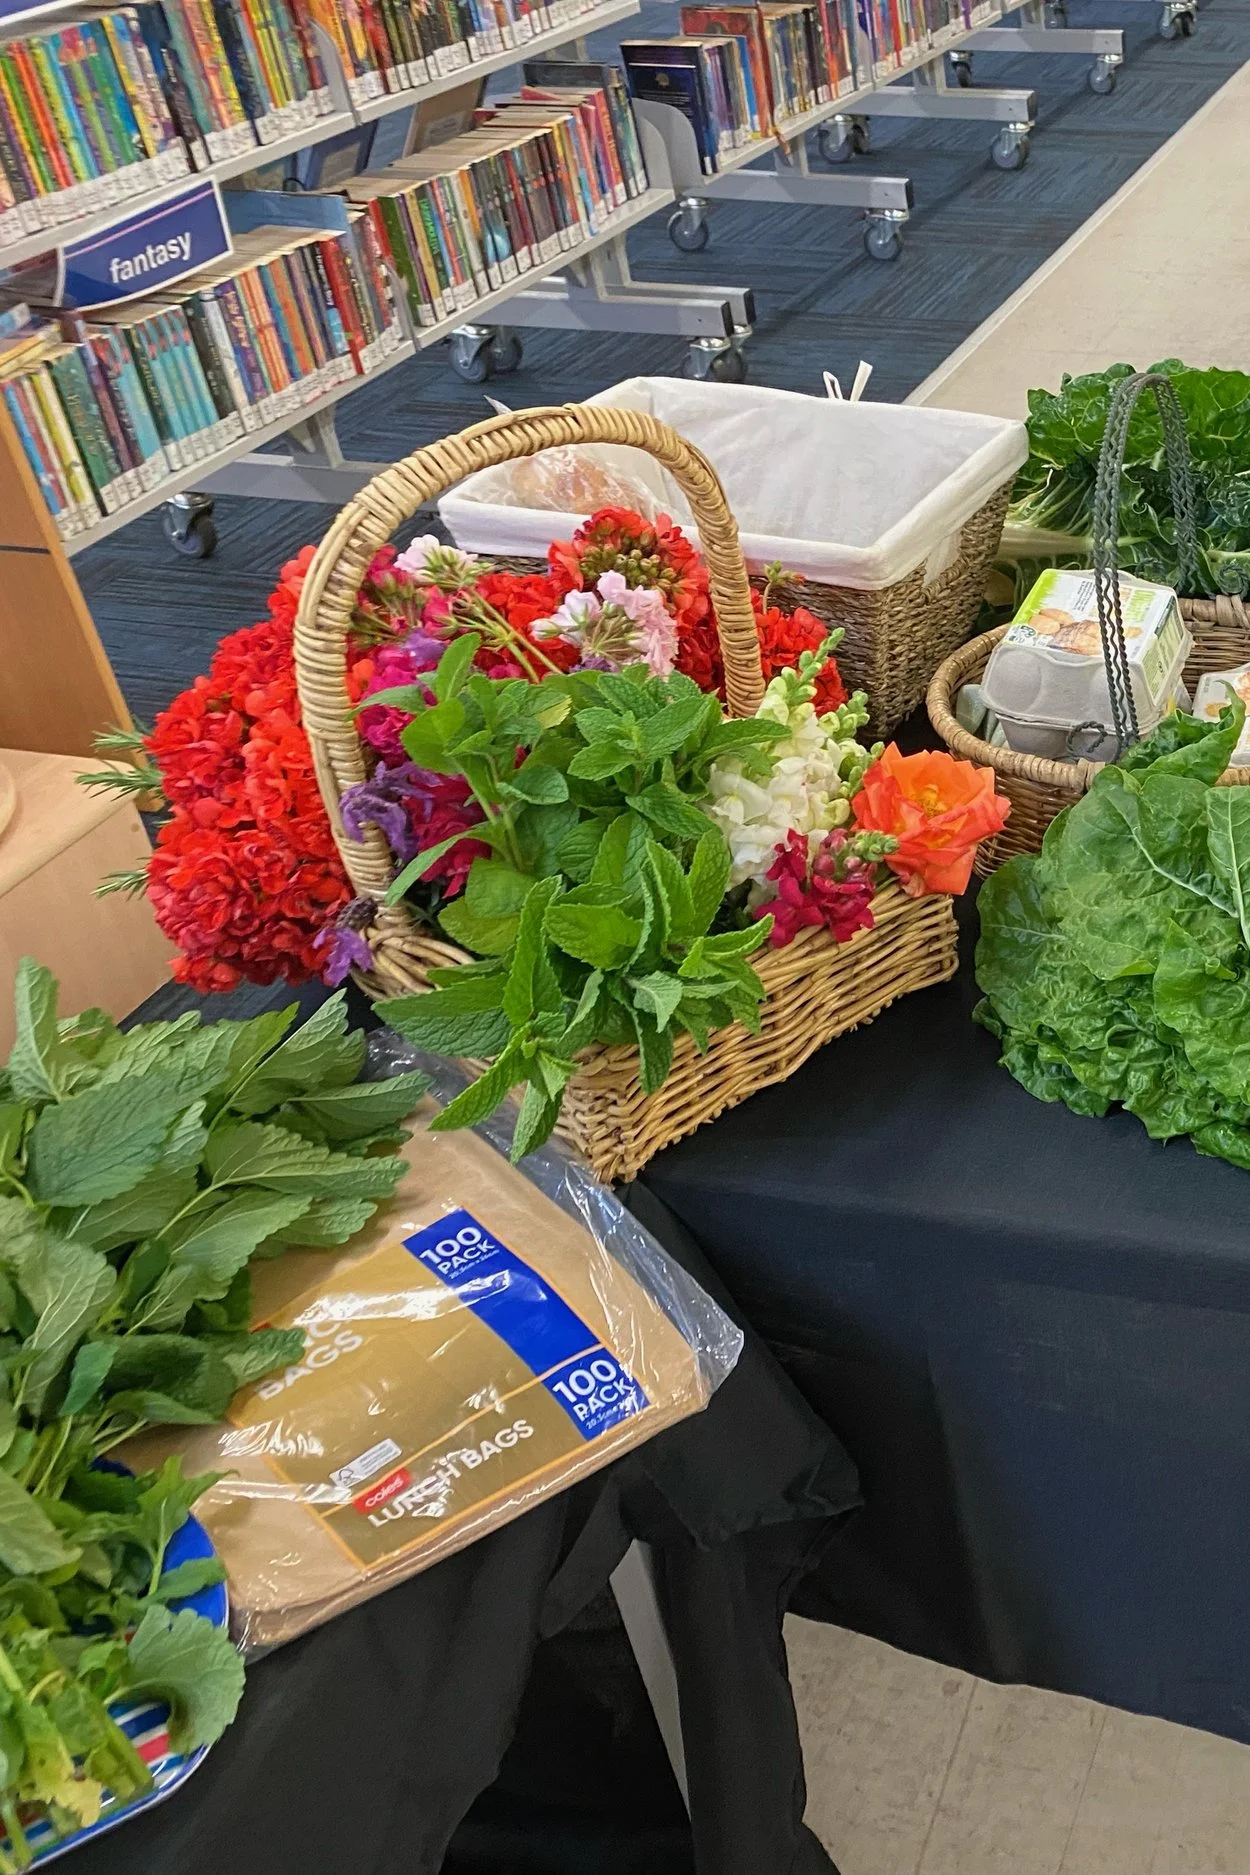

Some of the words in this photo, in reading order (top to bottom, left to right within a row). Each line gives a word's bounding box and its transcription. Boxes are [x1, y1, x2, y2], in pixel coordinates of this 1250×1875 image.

[109, 231, 192, 284] fantasy
[419, 1226, 482, 1264] 100
[437, 1239, 496, 1275] PACK
[552, 1359, 617, 1403] 100
[573, 1378, 635, 1422] PACK
[460, 1418, 534, 1459] BAGS
[364, 1476, 404, 1508] coles
